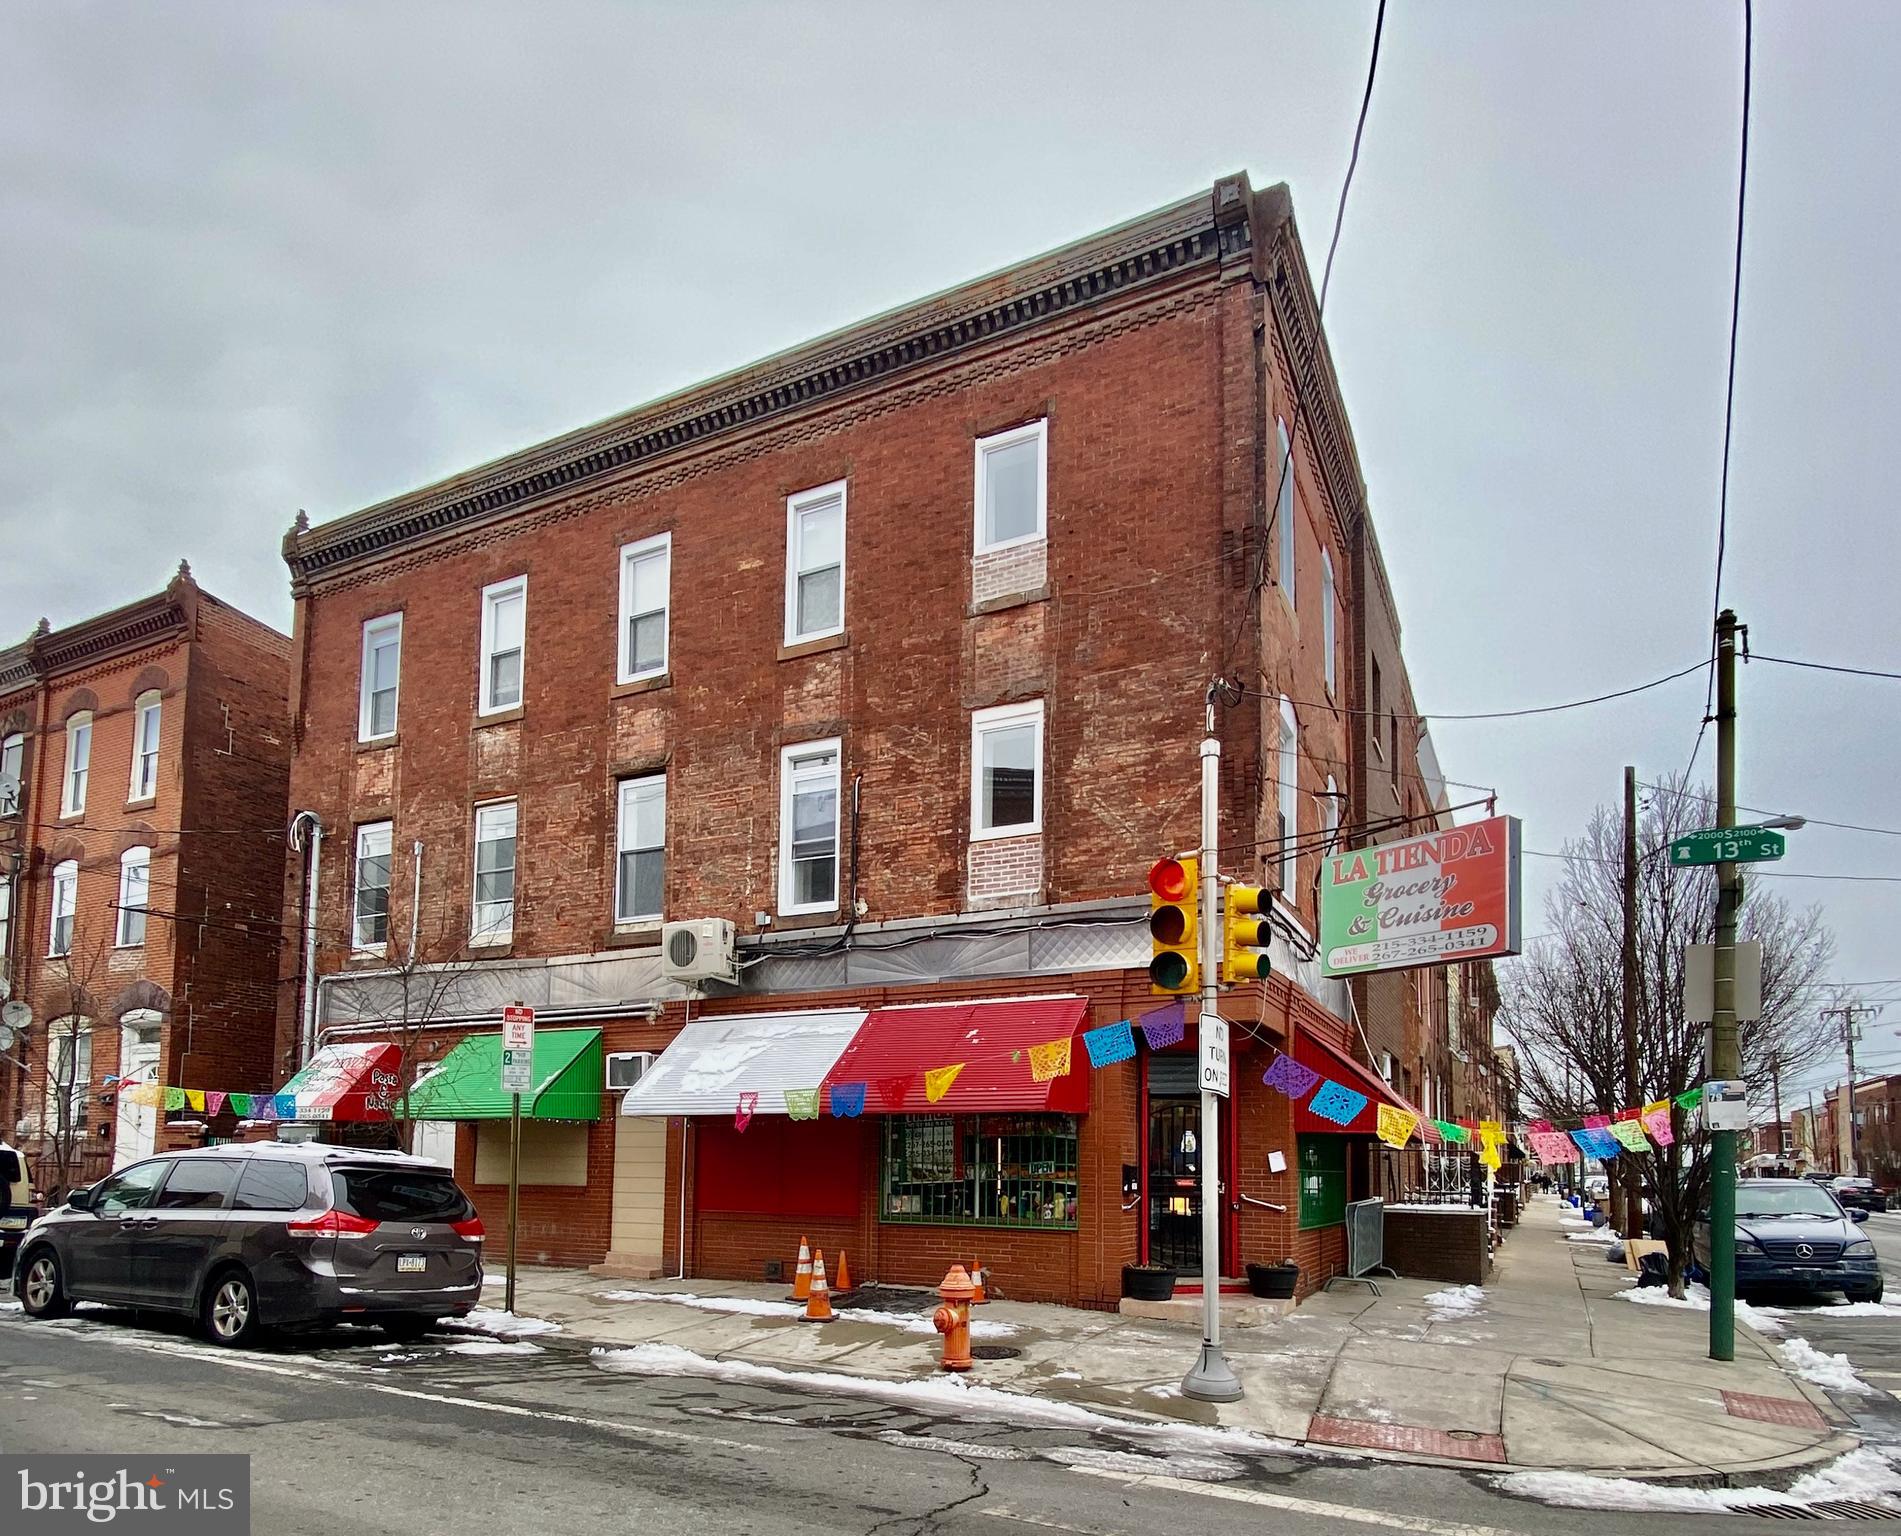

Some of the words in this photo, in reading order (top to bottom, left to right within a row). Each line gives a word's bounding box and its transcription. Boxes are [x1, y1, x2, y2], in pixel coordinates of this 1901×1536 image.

[1697, 832, 1724, 840] 2000
[1724, 829, 1733, 839] S
[1733, 829, 1757, 837] 2100
[1332, 855, 1368, 885] LA
[1374, 825, 1494, 876] TIENDA
[1713, 839, 1752, 859] 13th
[1760, 843, 1780, 856] St
[1364, 873, 1457, 907] Grocery
[1348, 915, 1372, 936] &
[1378, 900, 1474, 929] Cuisine
[1372, 926, 1488, 952] 215-334-1159
[1344, 948, 1358, 956] WE
[1372, 937, 1487, 961] 267-265-0341
[1333, 953, 1370, 965] DELIVER
[506, 1014, 532, 1022] STOPPING
[505, 1052, 511, 1064] 2
[372, 1068, 398, 1086] Pasta
[1204, 1067, 1219, 1083] ON
[1710, 1093, 1723, 1102] 79
[1031, 1162, 1052, 1173] OPEN
